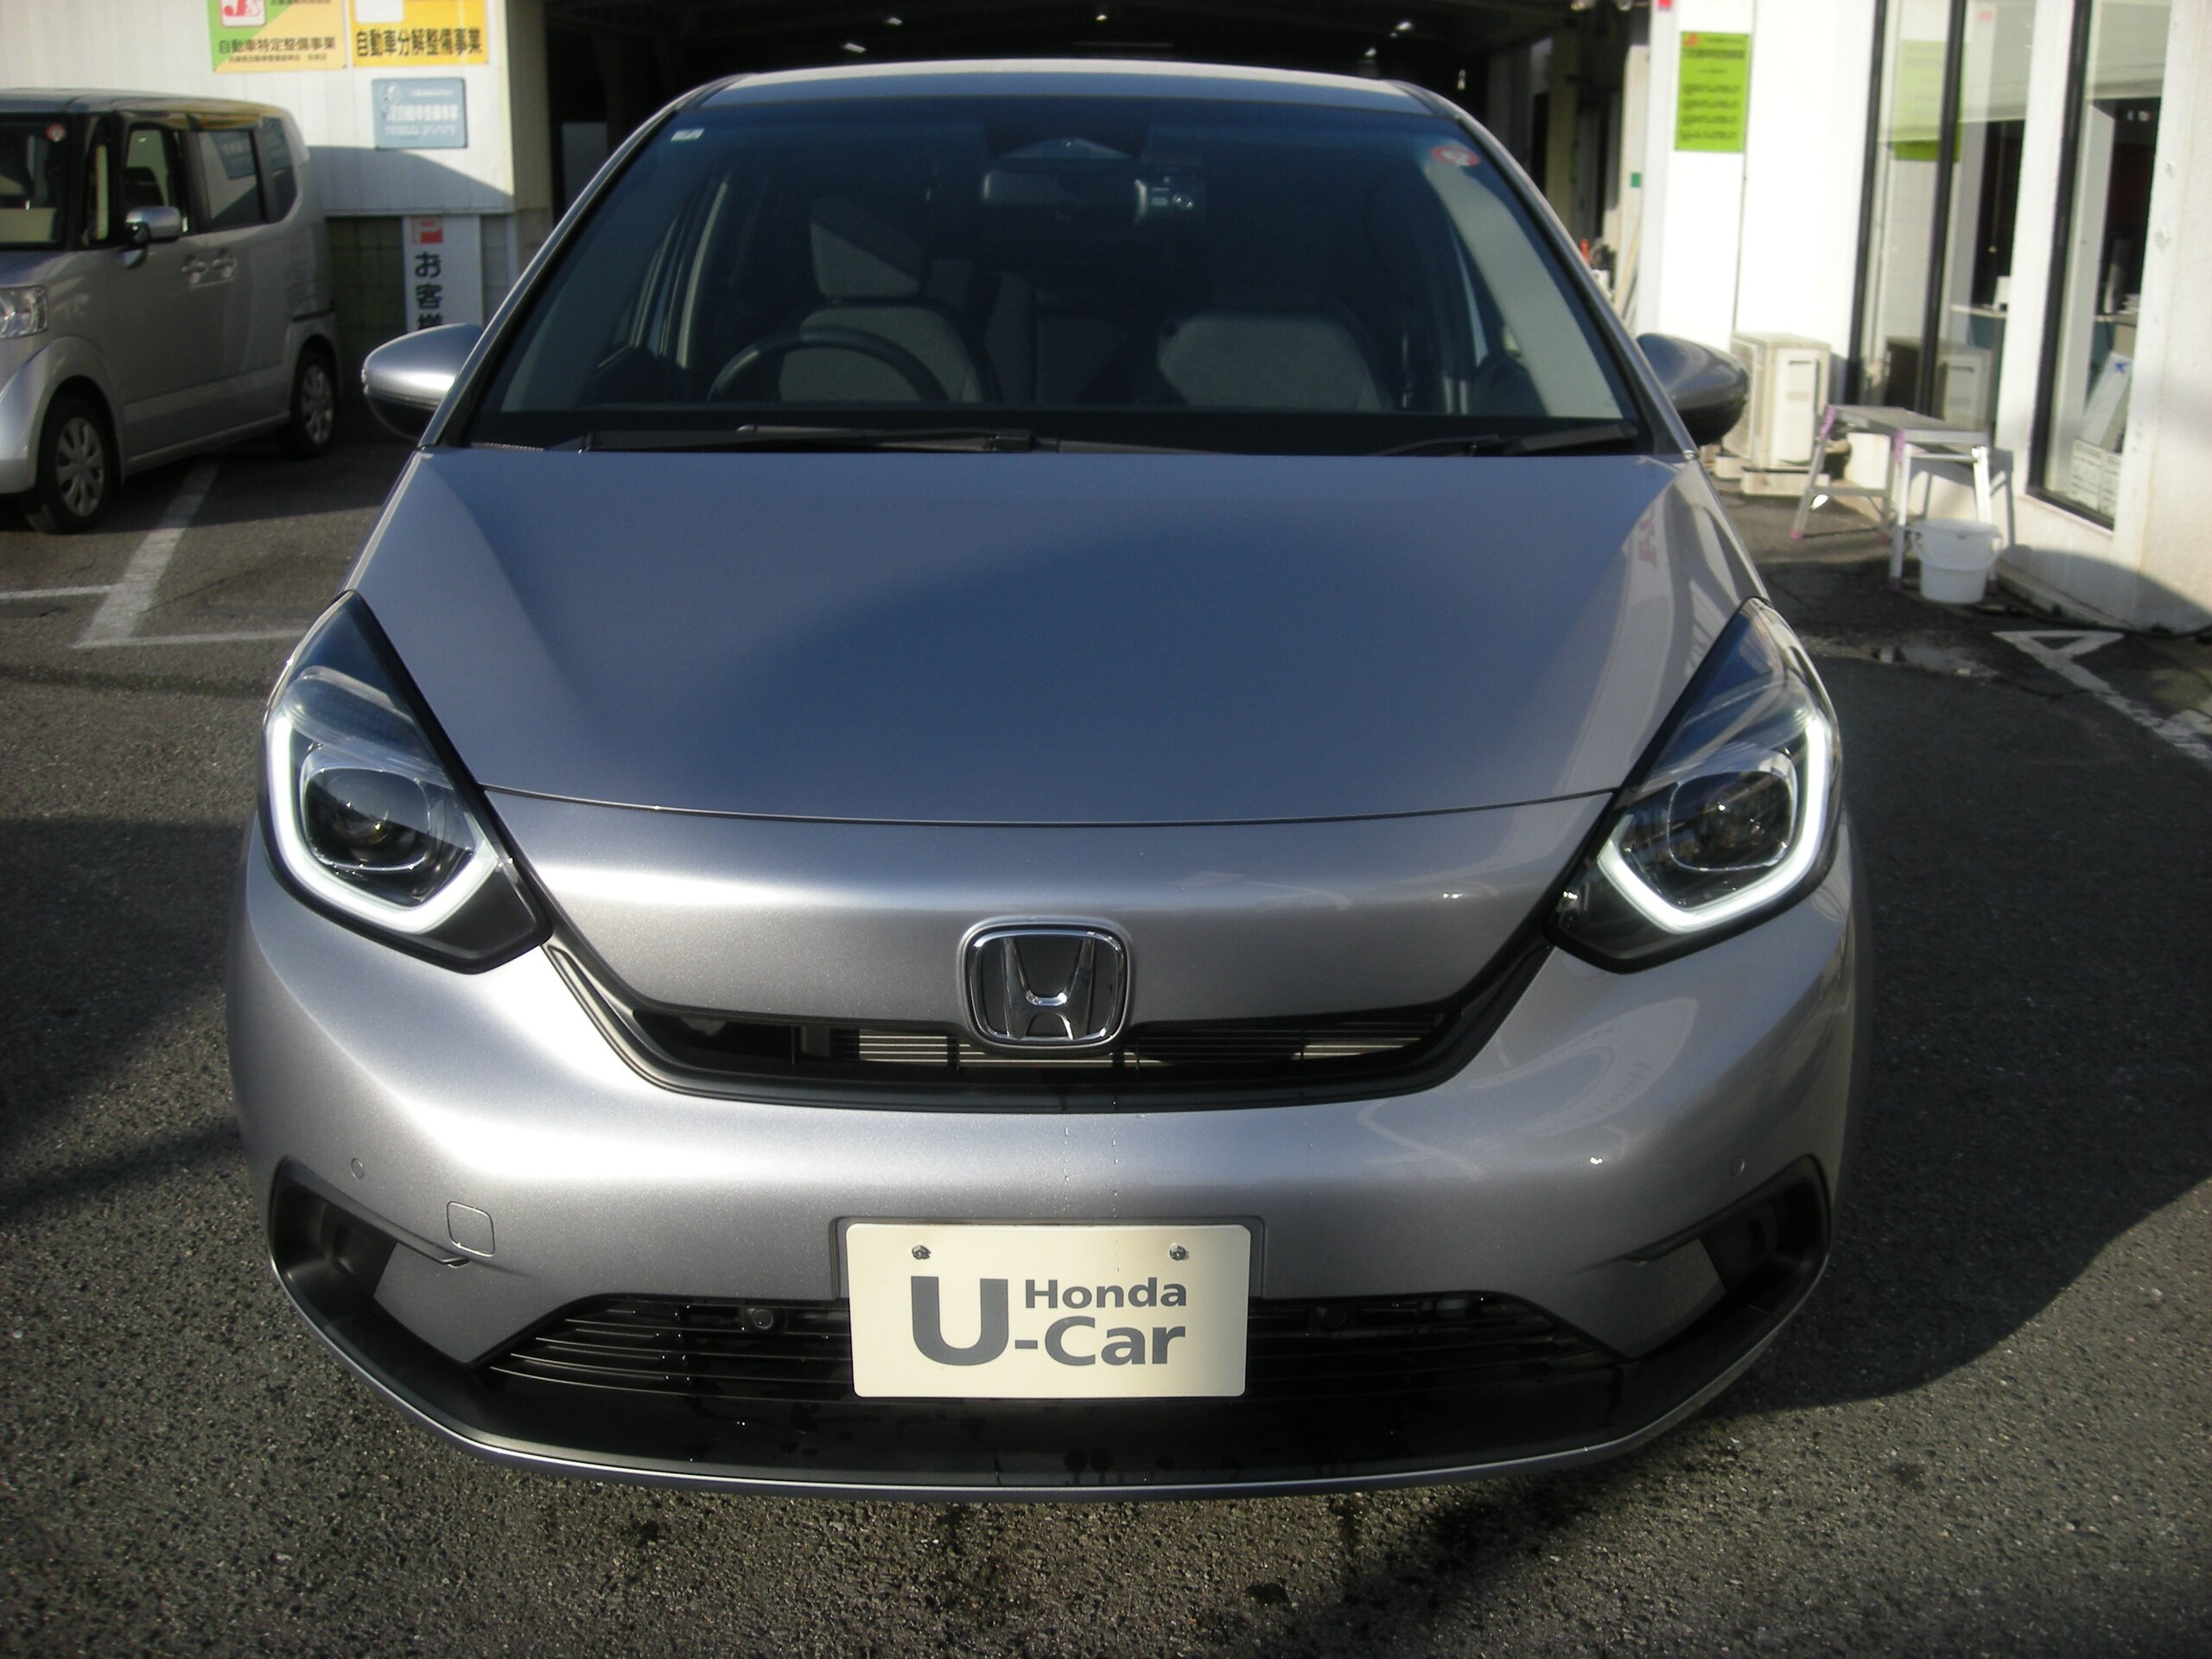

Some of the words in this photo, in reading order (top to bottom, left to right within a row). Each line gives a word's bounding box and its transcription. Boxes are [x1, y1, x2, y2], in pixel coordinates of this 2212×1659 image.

[219, 36, 335, 54] 自動車特定整備事業
[356, 28, 483, 57] 自動車分解整備事業
[1025, 1277, 1187, 1309] Honda
[911, 1275, 1186, 1367] U-Car
